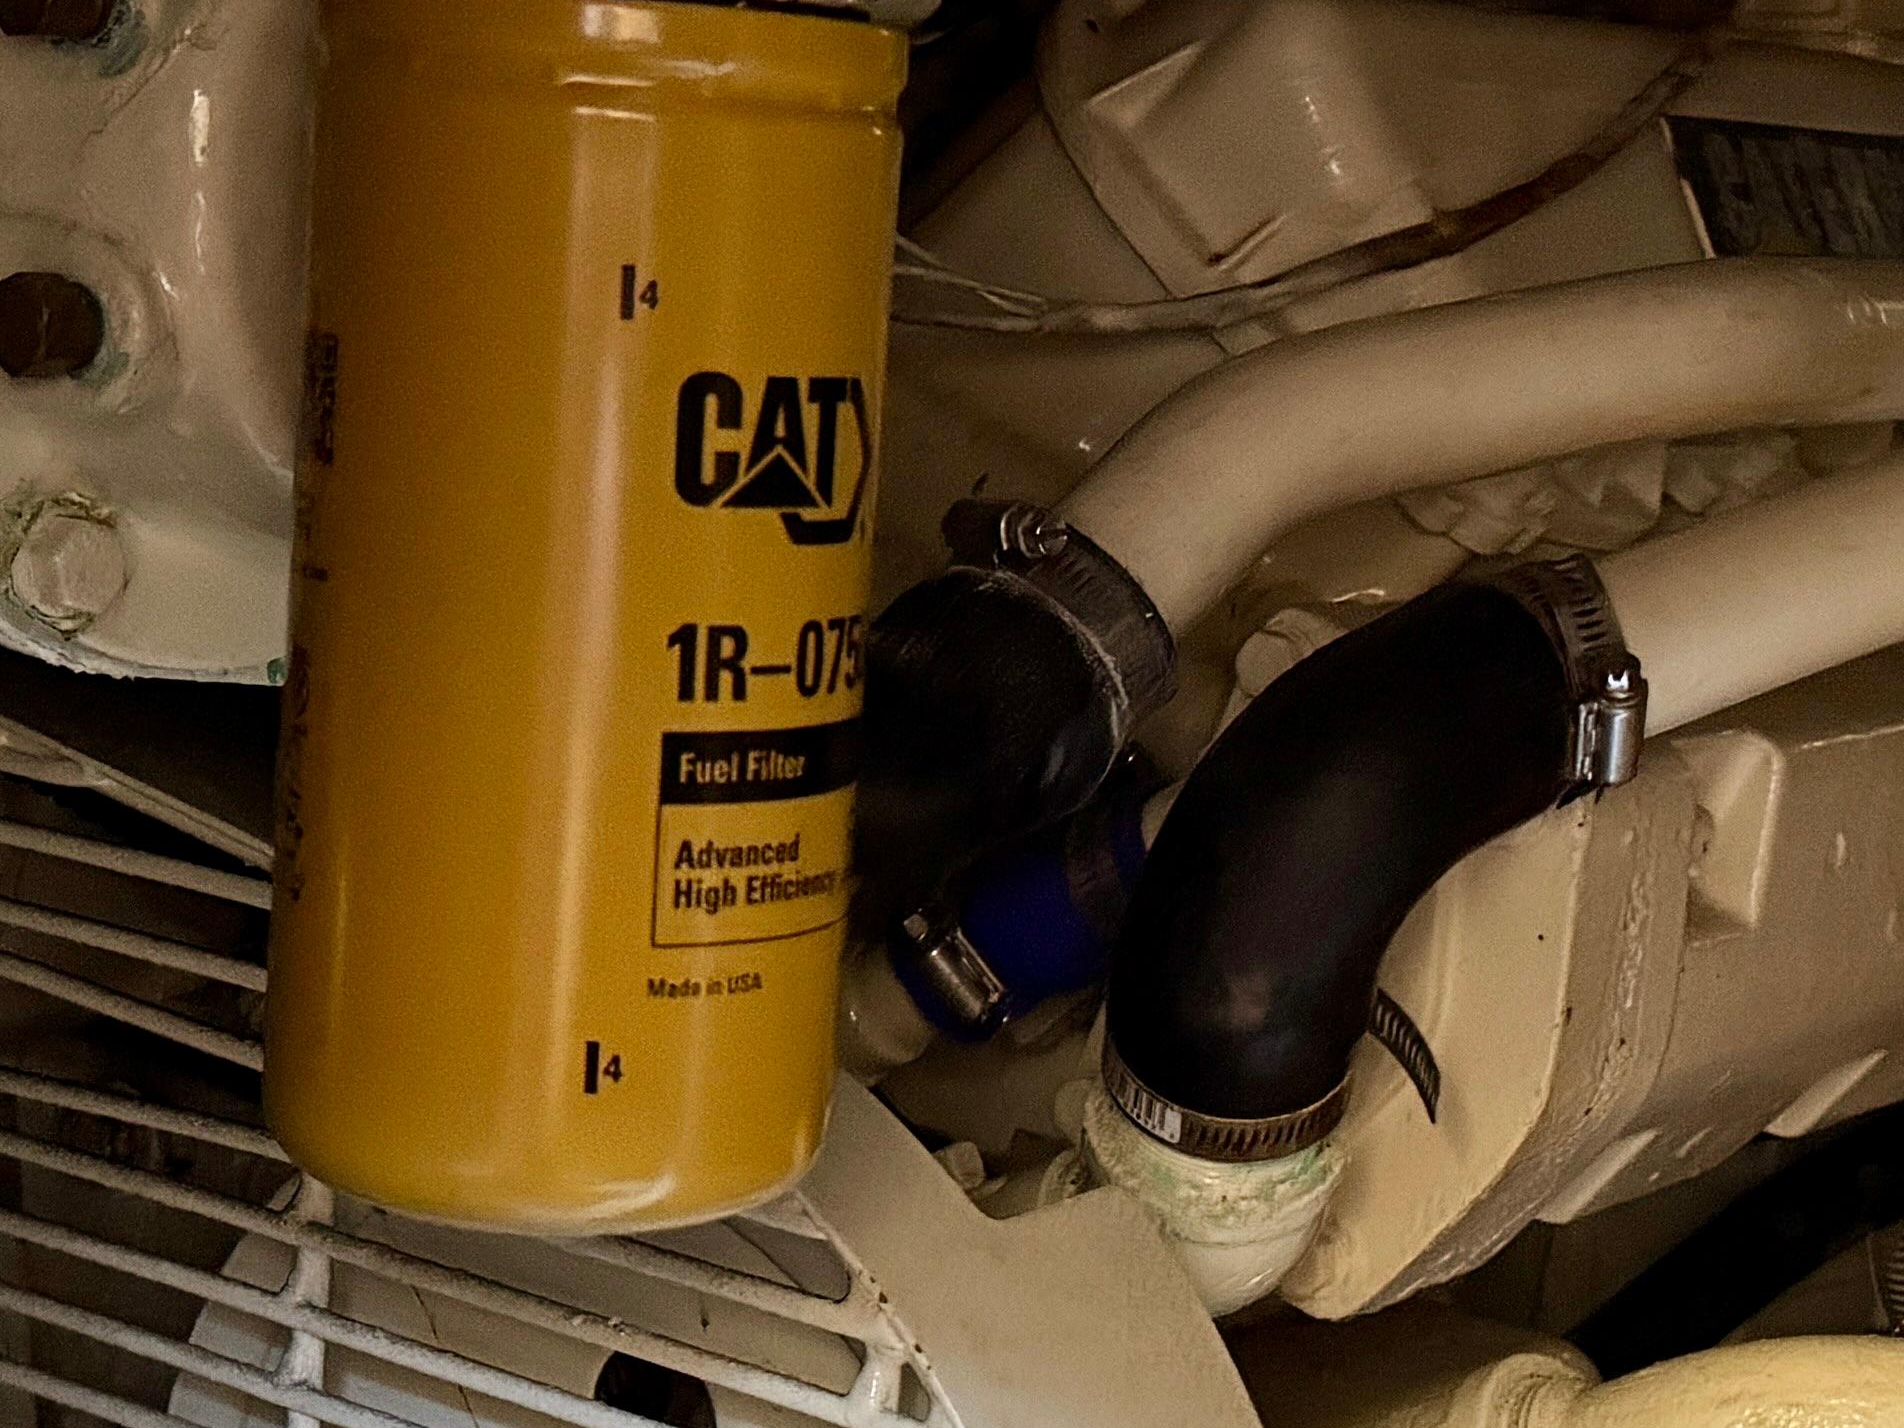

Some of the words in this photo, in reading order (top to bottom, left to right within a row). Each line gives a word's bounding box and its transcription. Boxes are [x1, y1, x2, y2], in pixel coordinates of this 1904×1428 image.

[674, 371, 849, 508] CAT
[679, 750, 740, 784] Fuel
[747, 748, 806, 781] Filter
[674, 833, 800, 870] Advanced
[674, 877, 738, 915] High
[647, 977, 700, 999] Made
[706, 976, 723, 995] in
[727, 972, 763, 994] USA
